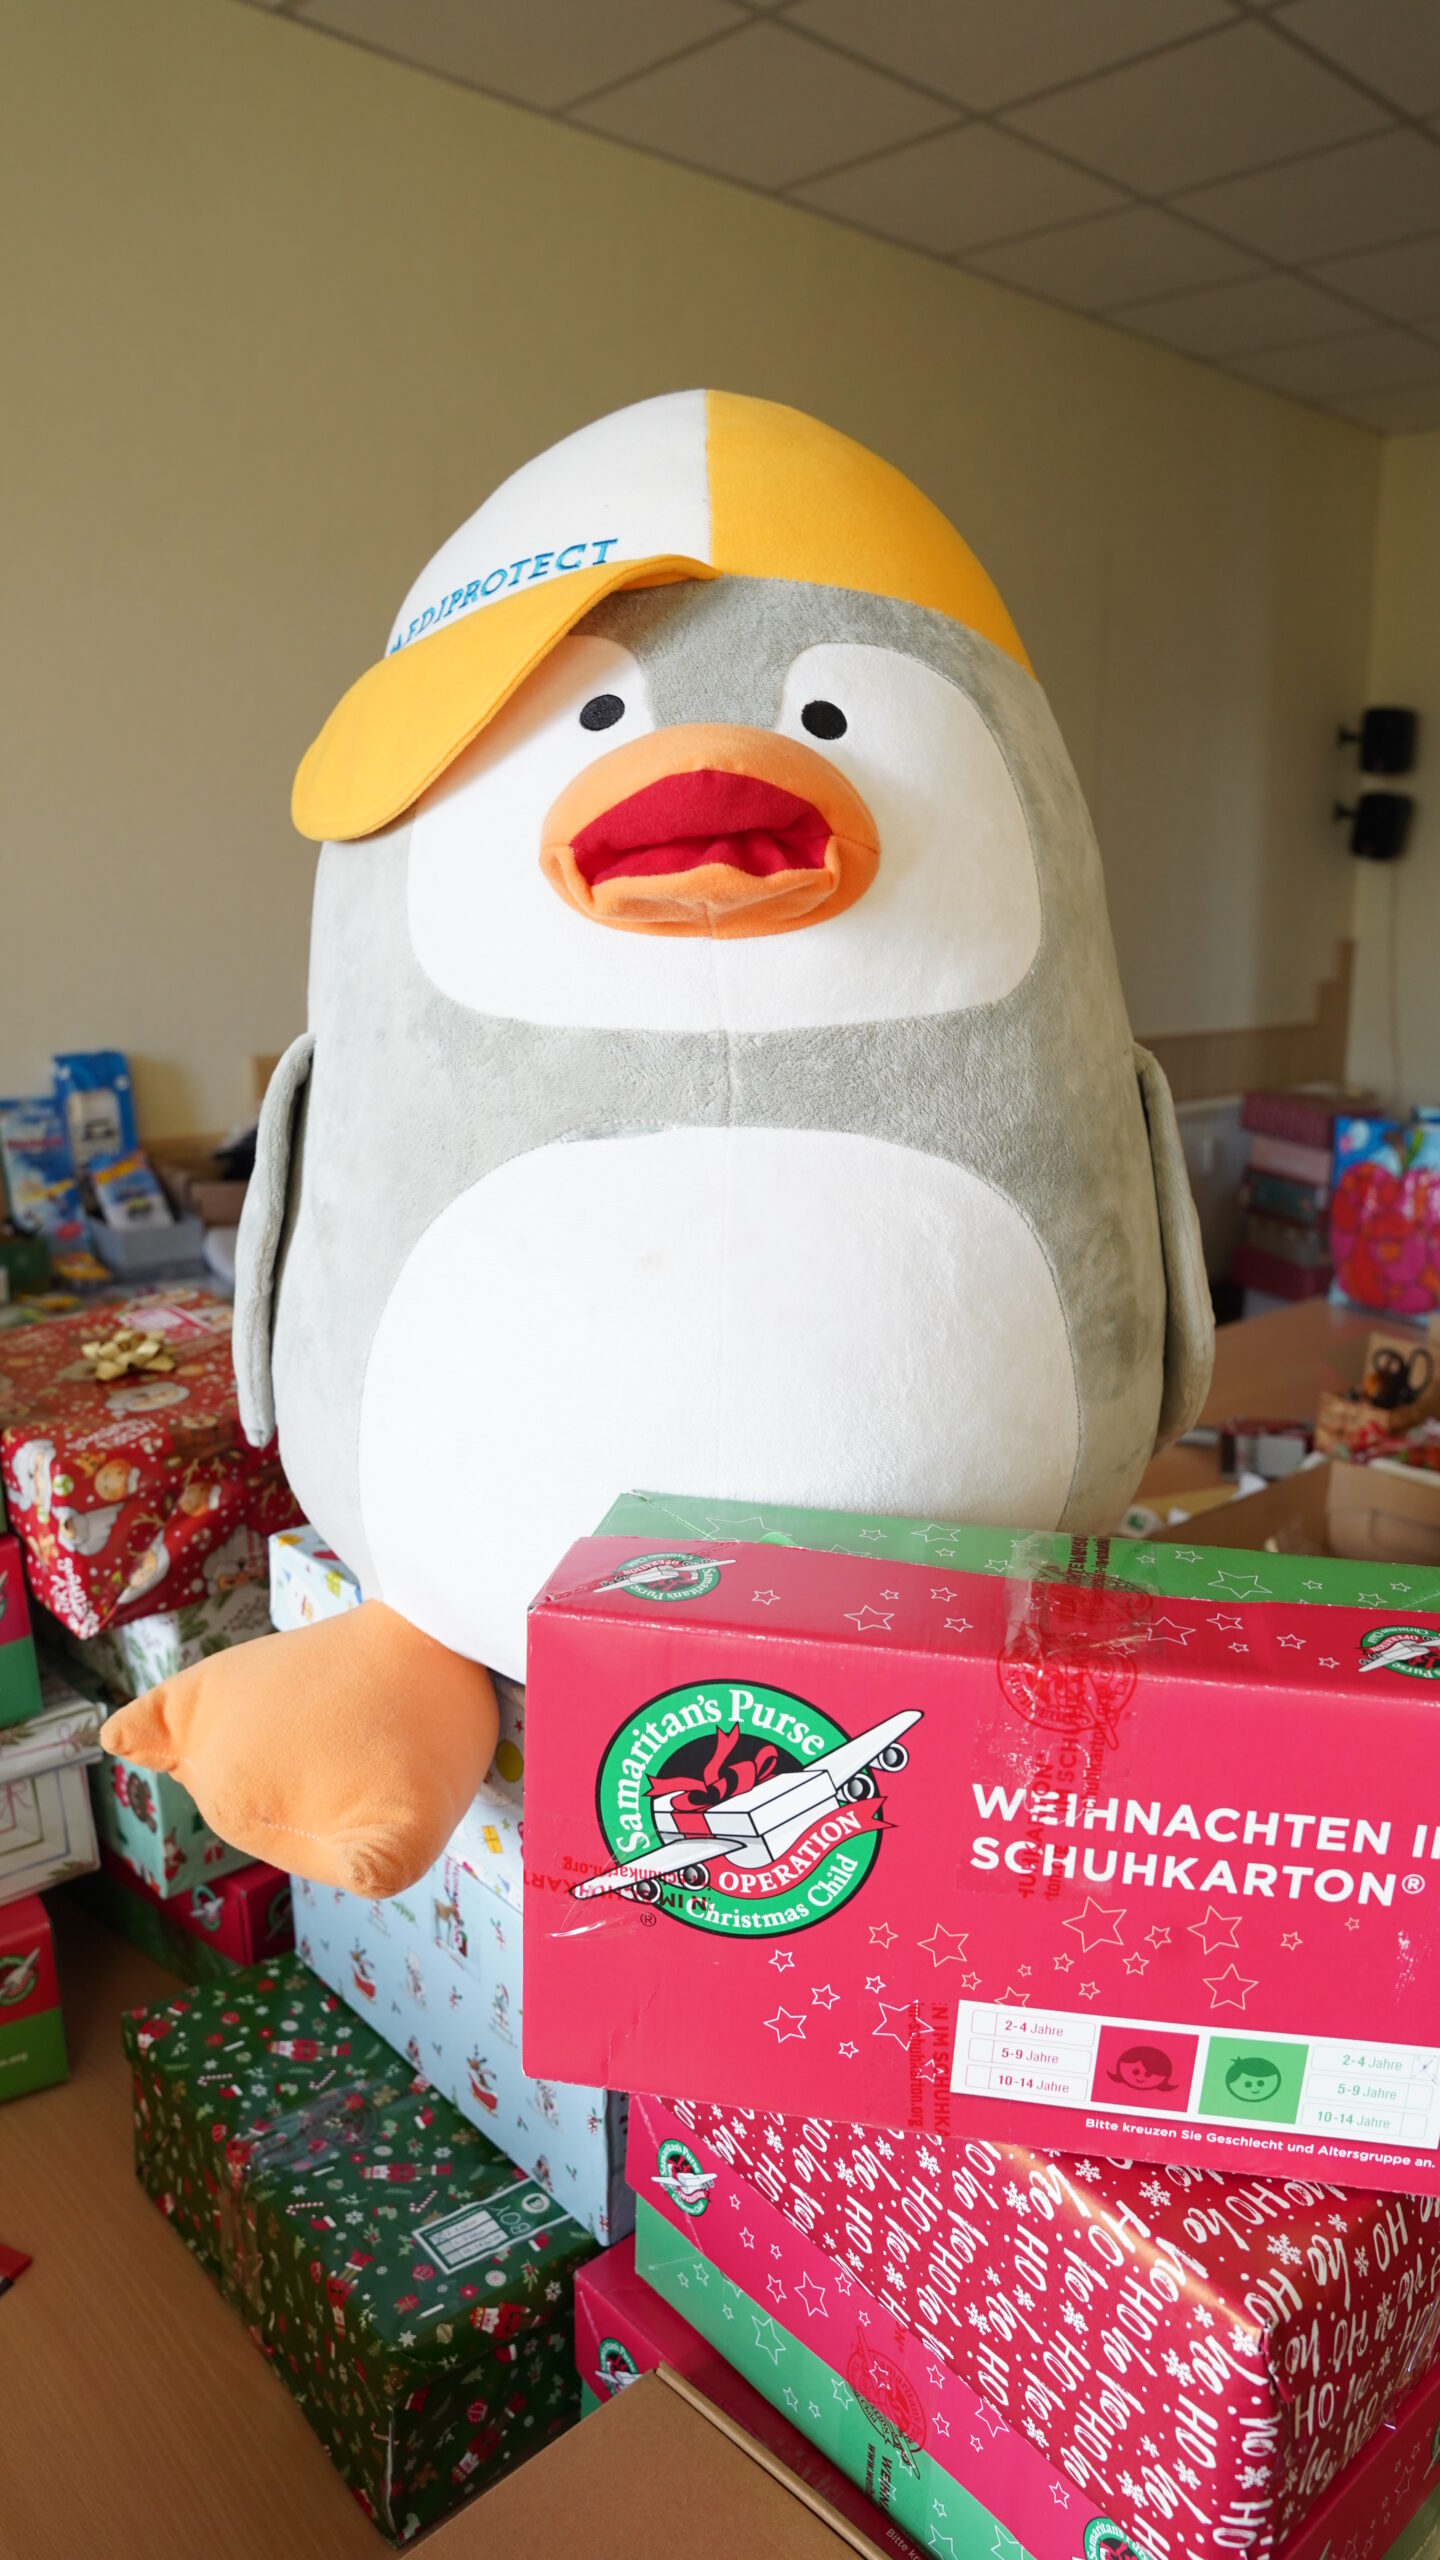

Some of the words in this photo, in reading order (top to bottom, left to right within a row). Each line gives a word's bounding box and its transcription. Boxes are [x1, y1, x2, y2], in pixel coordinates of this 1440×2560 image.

[630, 1584, 664, 1600] Purse
[615, 1694, 722, 1853] Samaritan's
[728, 1689, 826, 1757] Purse
[972, 1783, 1391, 1855] WEIHNACHTEN
[718, 1809, 863, 1894] OPERATION
[685, 1894, 810, 1929] Christmas
[806, 1852, 859, 1908] Child
[932, 2025, 949, 2046] IM
[1001, 2047, 1023, 2060] 5-9
[1026, 2051, 1059, 2064] Jahre
[1030, 2023, 1064, 2037] Jahre
[998, 2075, 1033, 2089] 10-14
[1036, 2080, 1069, 2093] Jahre
[1368, 2057, 1403, 2071] Jahre
[1362, 2086, 1397, 2100] Jahre
[712, 2125, 753, 2165] ho
[1085, 2118, 1118, 2131] Bitte
[1122, 2121, 1177, 2138] kreuzen
[1180, 2128, 1202, 2142] Sie
[1206, 2132, 1283, 2151] Geschlecht
[1287, 2142, 1314, 2154] und
[1317, 2145, 1411, 2167] Altersgruppe
[1414, 2157, 1435, 2168] an.
[1356, 2115, 1391, 2129] Jahre
[754, 2153, 788, 2202] HO
[791, 2144, 832, 2183] ho
[852, 2144, 901, 2192] ho
[951, 2166, 999, 2210] ho
[790, 2182, 825, 2231] ho
[901, 2176, 943, 2233] HO
[1029, 2163, 1092, 2221] ho
[1225, 2182, 1290, 2226] HO
[490, 2204, 532, 2235] BOY
[845, 2195, 873, 2254] HO
[884, 2215, 922, 2264] ho
[947, 2208, 989, 2264] ho
[1088, 2200, 1151, 2267] HO
[1182, 2207, 1250, 2251] ho
[1372, 2202, 1409, 2272] HO
[928, 2240, 964, 2296] HO
[1014, 2224, 1049, 2292] HO
[1064, 2247, 1109, 2302] ho
[1149, 2237, 1209, 2302] ho
[1306, 2234, 1351, 2311] ho
[916, 2283, 962, 2328] ho
[985, 2292, 1044, 2345] ho
[1116, 2275, 1164, 2341] HO
[1244, 2268, 1303, 2335] HO
[976, 2341, 1010, 2406] HO
[1043, 2330, 1091, 2391] HO
[1101, 2327, 1158, 2375] ho
[1189, 2335, 1269, 2395] ho
[1284, 2318, 1320, 2378] ho
[1024, 2368, 1066, 2421] ho
[1095, 2369, 1146, 2431] ho
[1295, 2382, 1335, 2439] HO
[1074, 2400, 1115, 2462] HO
[1174, 2393, 1219, 2469] HO
[1239, 2410, 1282, 2457] ho
[1061, 2445, 1114, 2496] ho
[1141, 2463, 1213, 2520] ho
[886, 2528, 909, 2551] Bitte
[1087, 2521, 1124, 2560] Samaritans
[1132, 2513, 1171, 2560] H
[1212, 2498, 1274, 2549] HO
